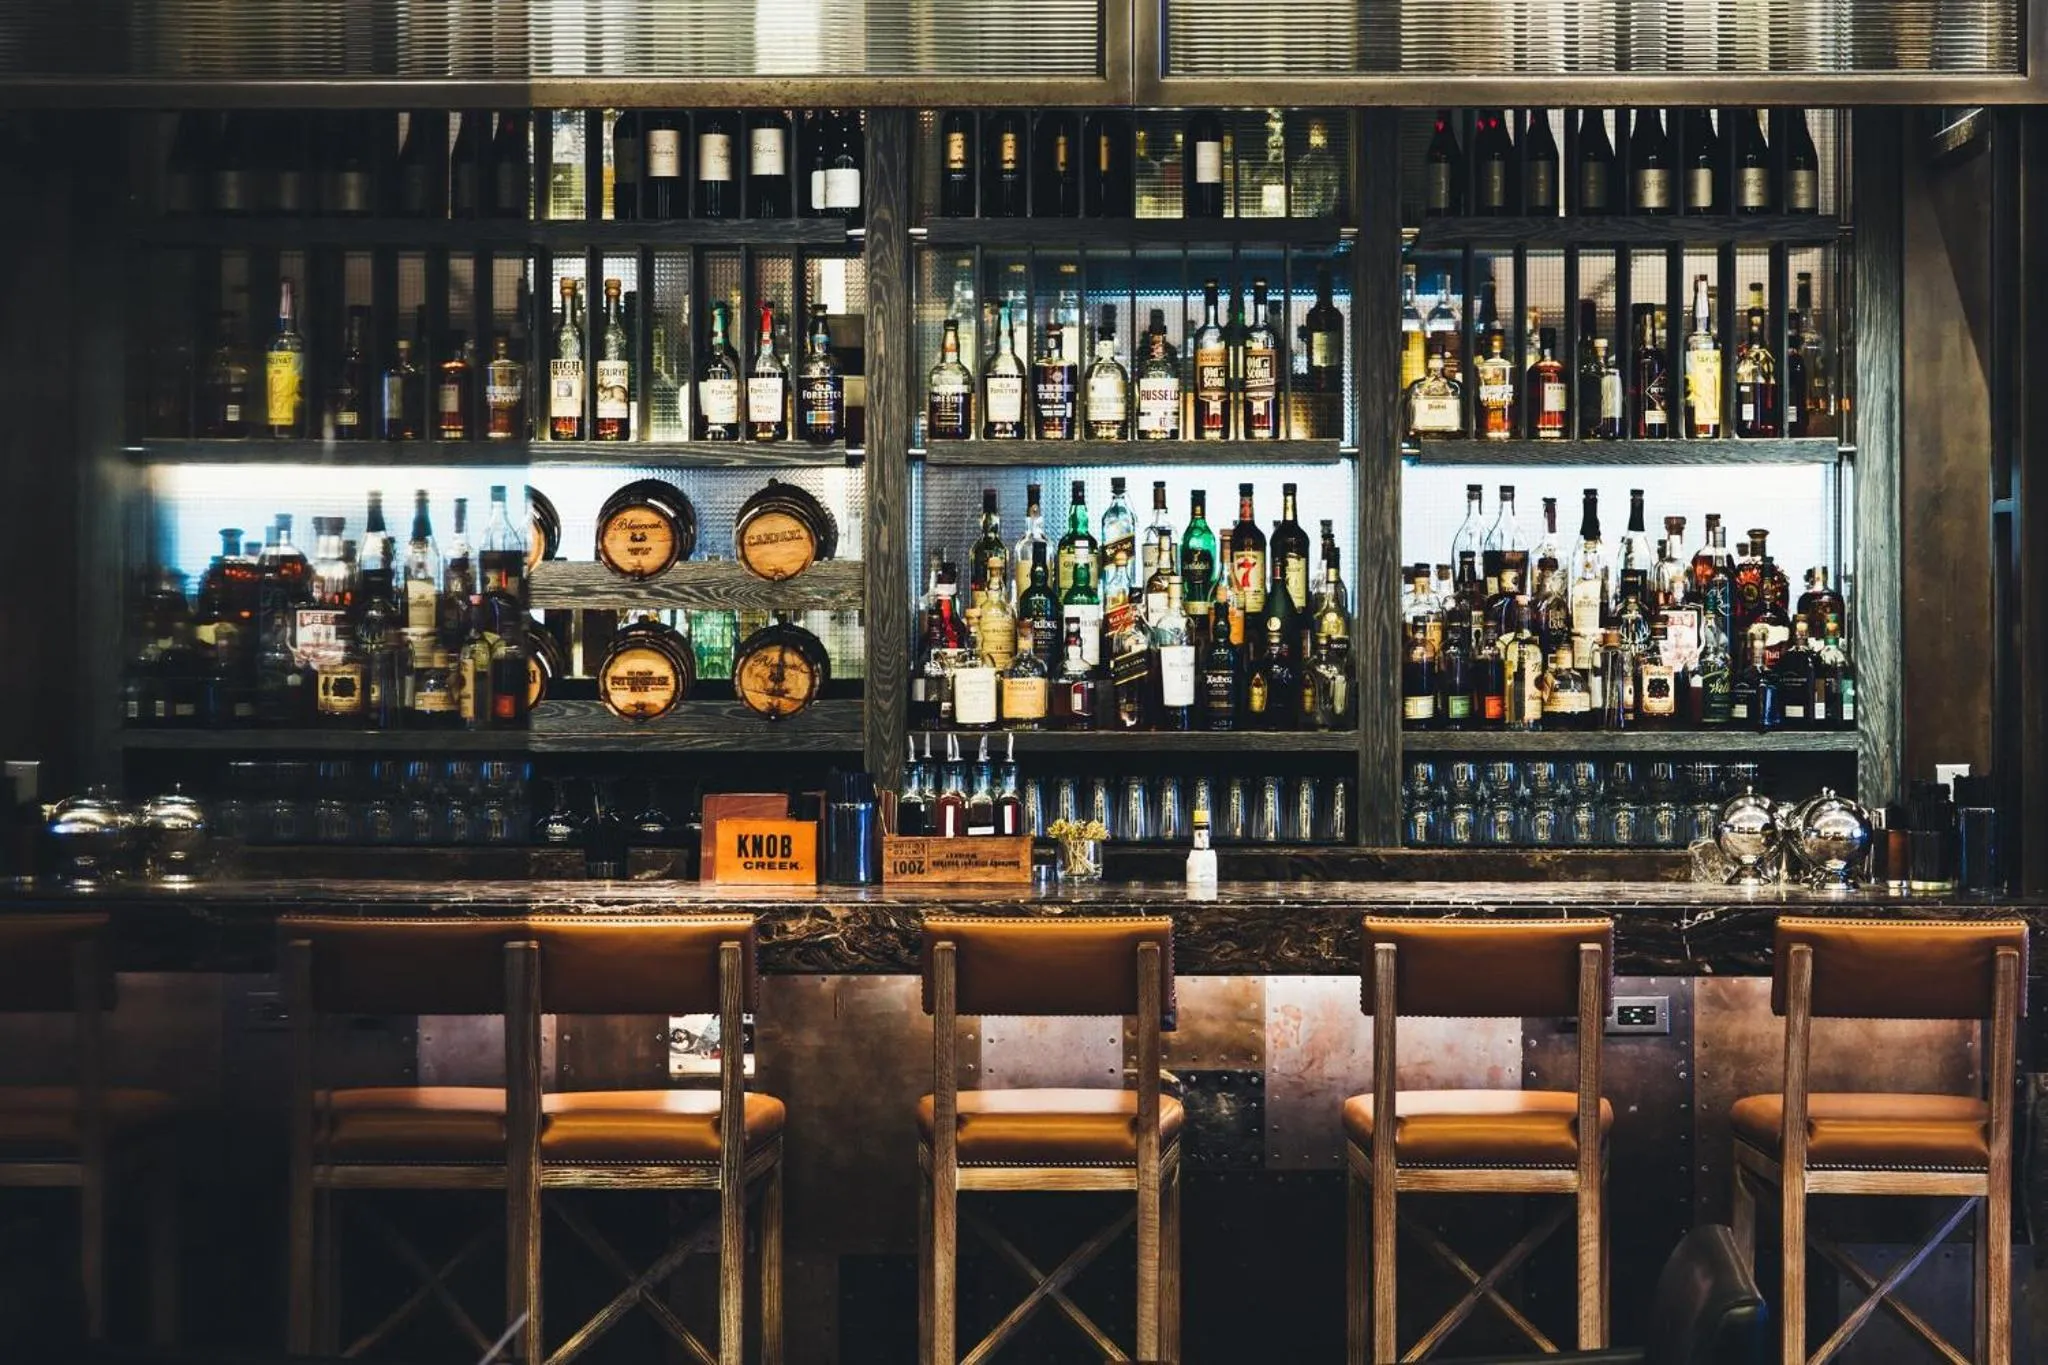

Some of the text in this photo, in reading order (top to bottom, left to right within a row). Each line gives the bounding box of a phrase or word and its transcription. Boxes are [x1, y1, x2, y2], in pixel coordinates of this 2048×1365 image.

[552, 361, 580, 370] HIGH
[814, 383, 831, 391] OLD
[737, 834, 792, 859] KNOB
[893, 860, 926, 876] 2001
